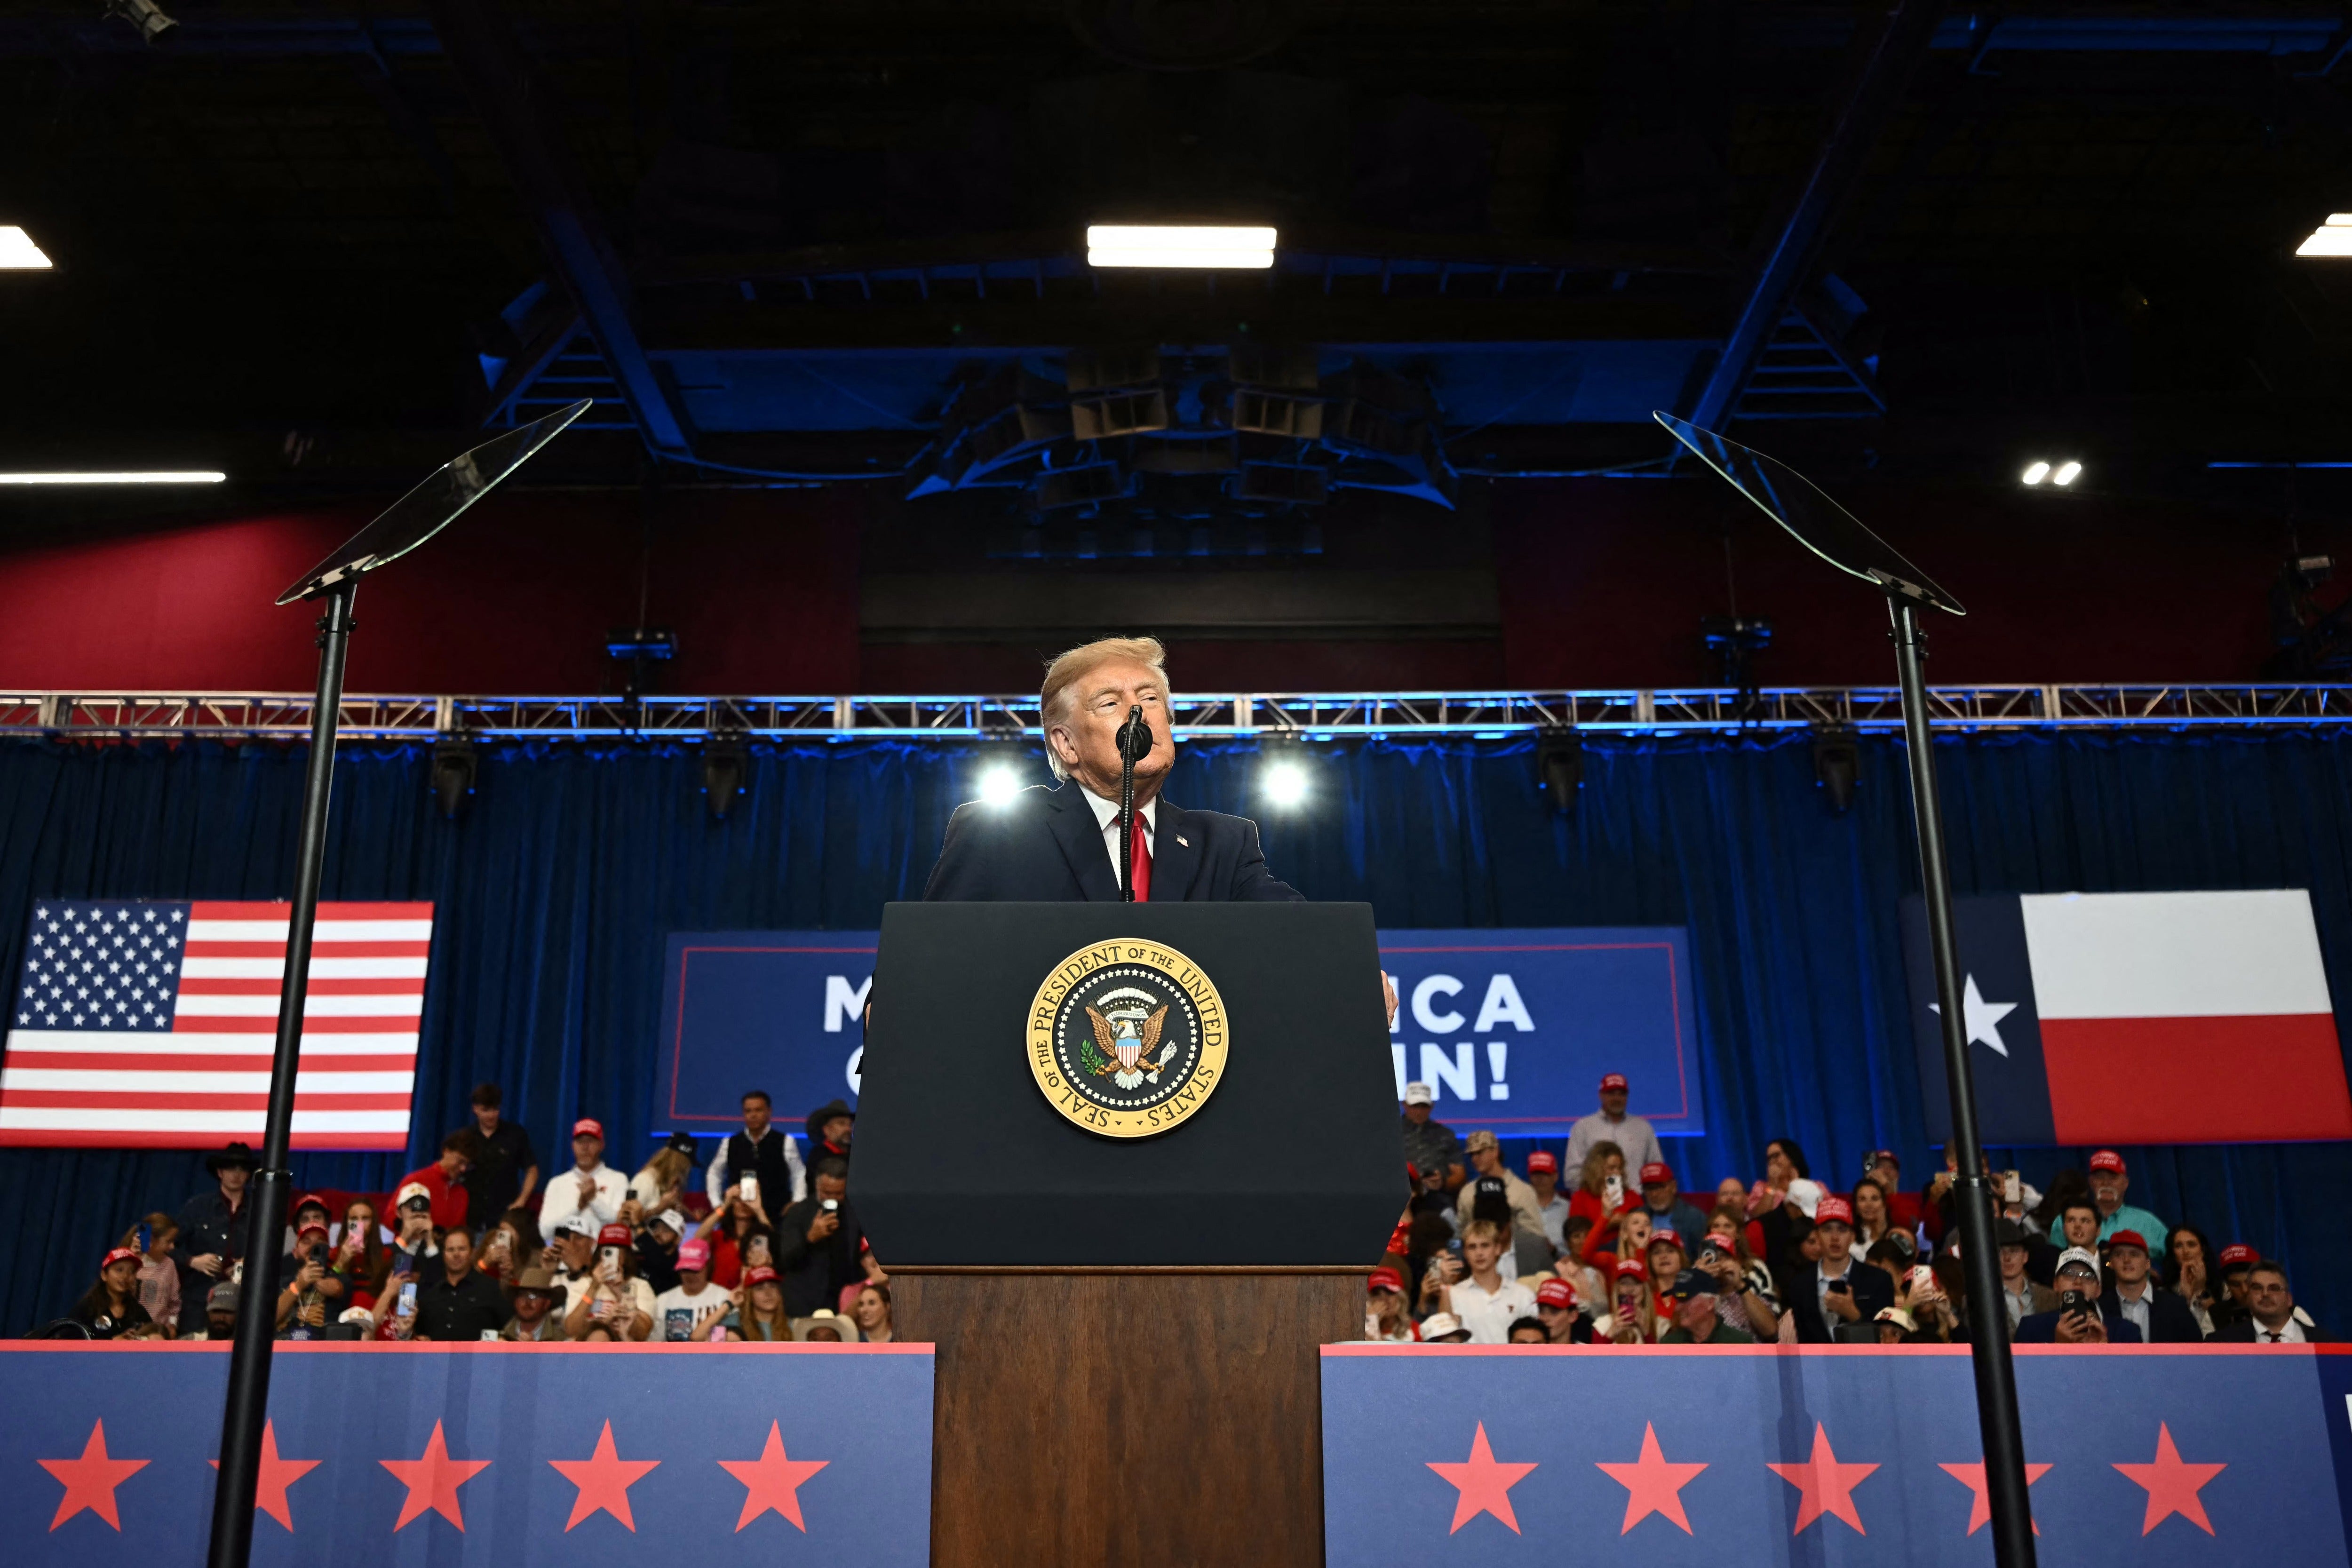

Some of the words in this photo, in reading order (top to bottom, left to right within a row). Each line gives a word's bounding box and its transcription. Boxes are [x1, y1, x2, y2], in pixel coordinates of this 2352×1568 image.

[1128, 948, 1146, 958] OF
[1151, 951, 1175, 969] THE
[824, 975, 872, 1033] M
[1034, 946, 1121, 1032] PRESIDENT
[1180, 967, 1221, 1046] UNITED
[1036, 1040, 1050, 1067] THE
[1391, 1042, 1510, 1101] IN!
[1044, 1071, 1059, 1087] OF
[1148, 1065, 1214, 1126] STATES
[1059, 1086, 1110, 1127] SEAL
